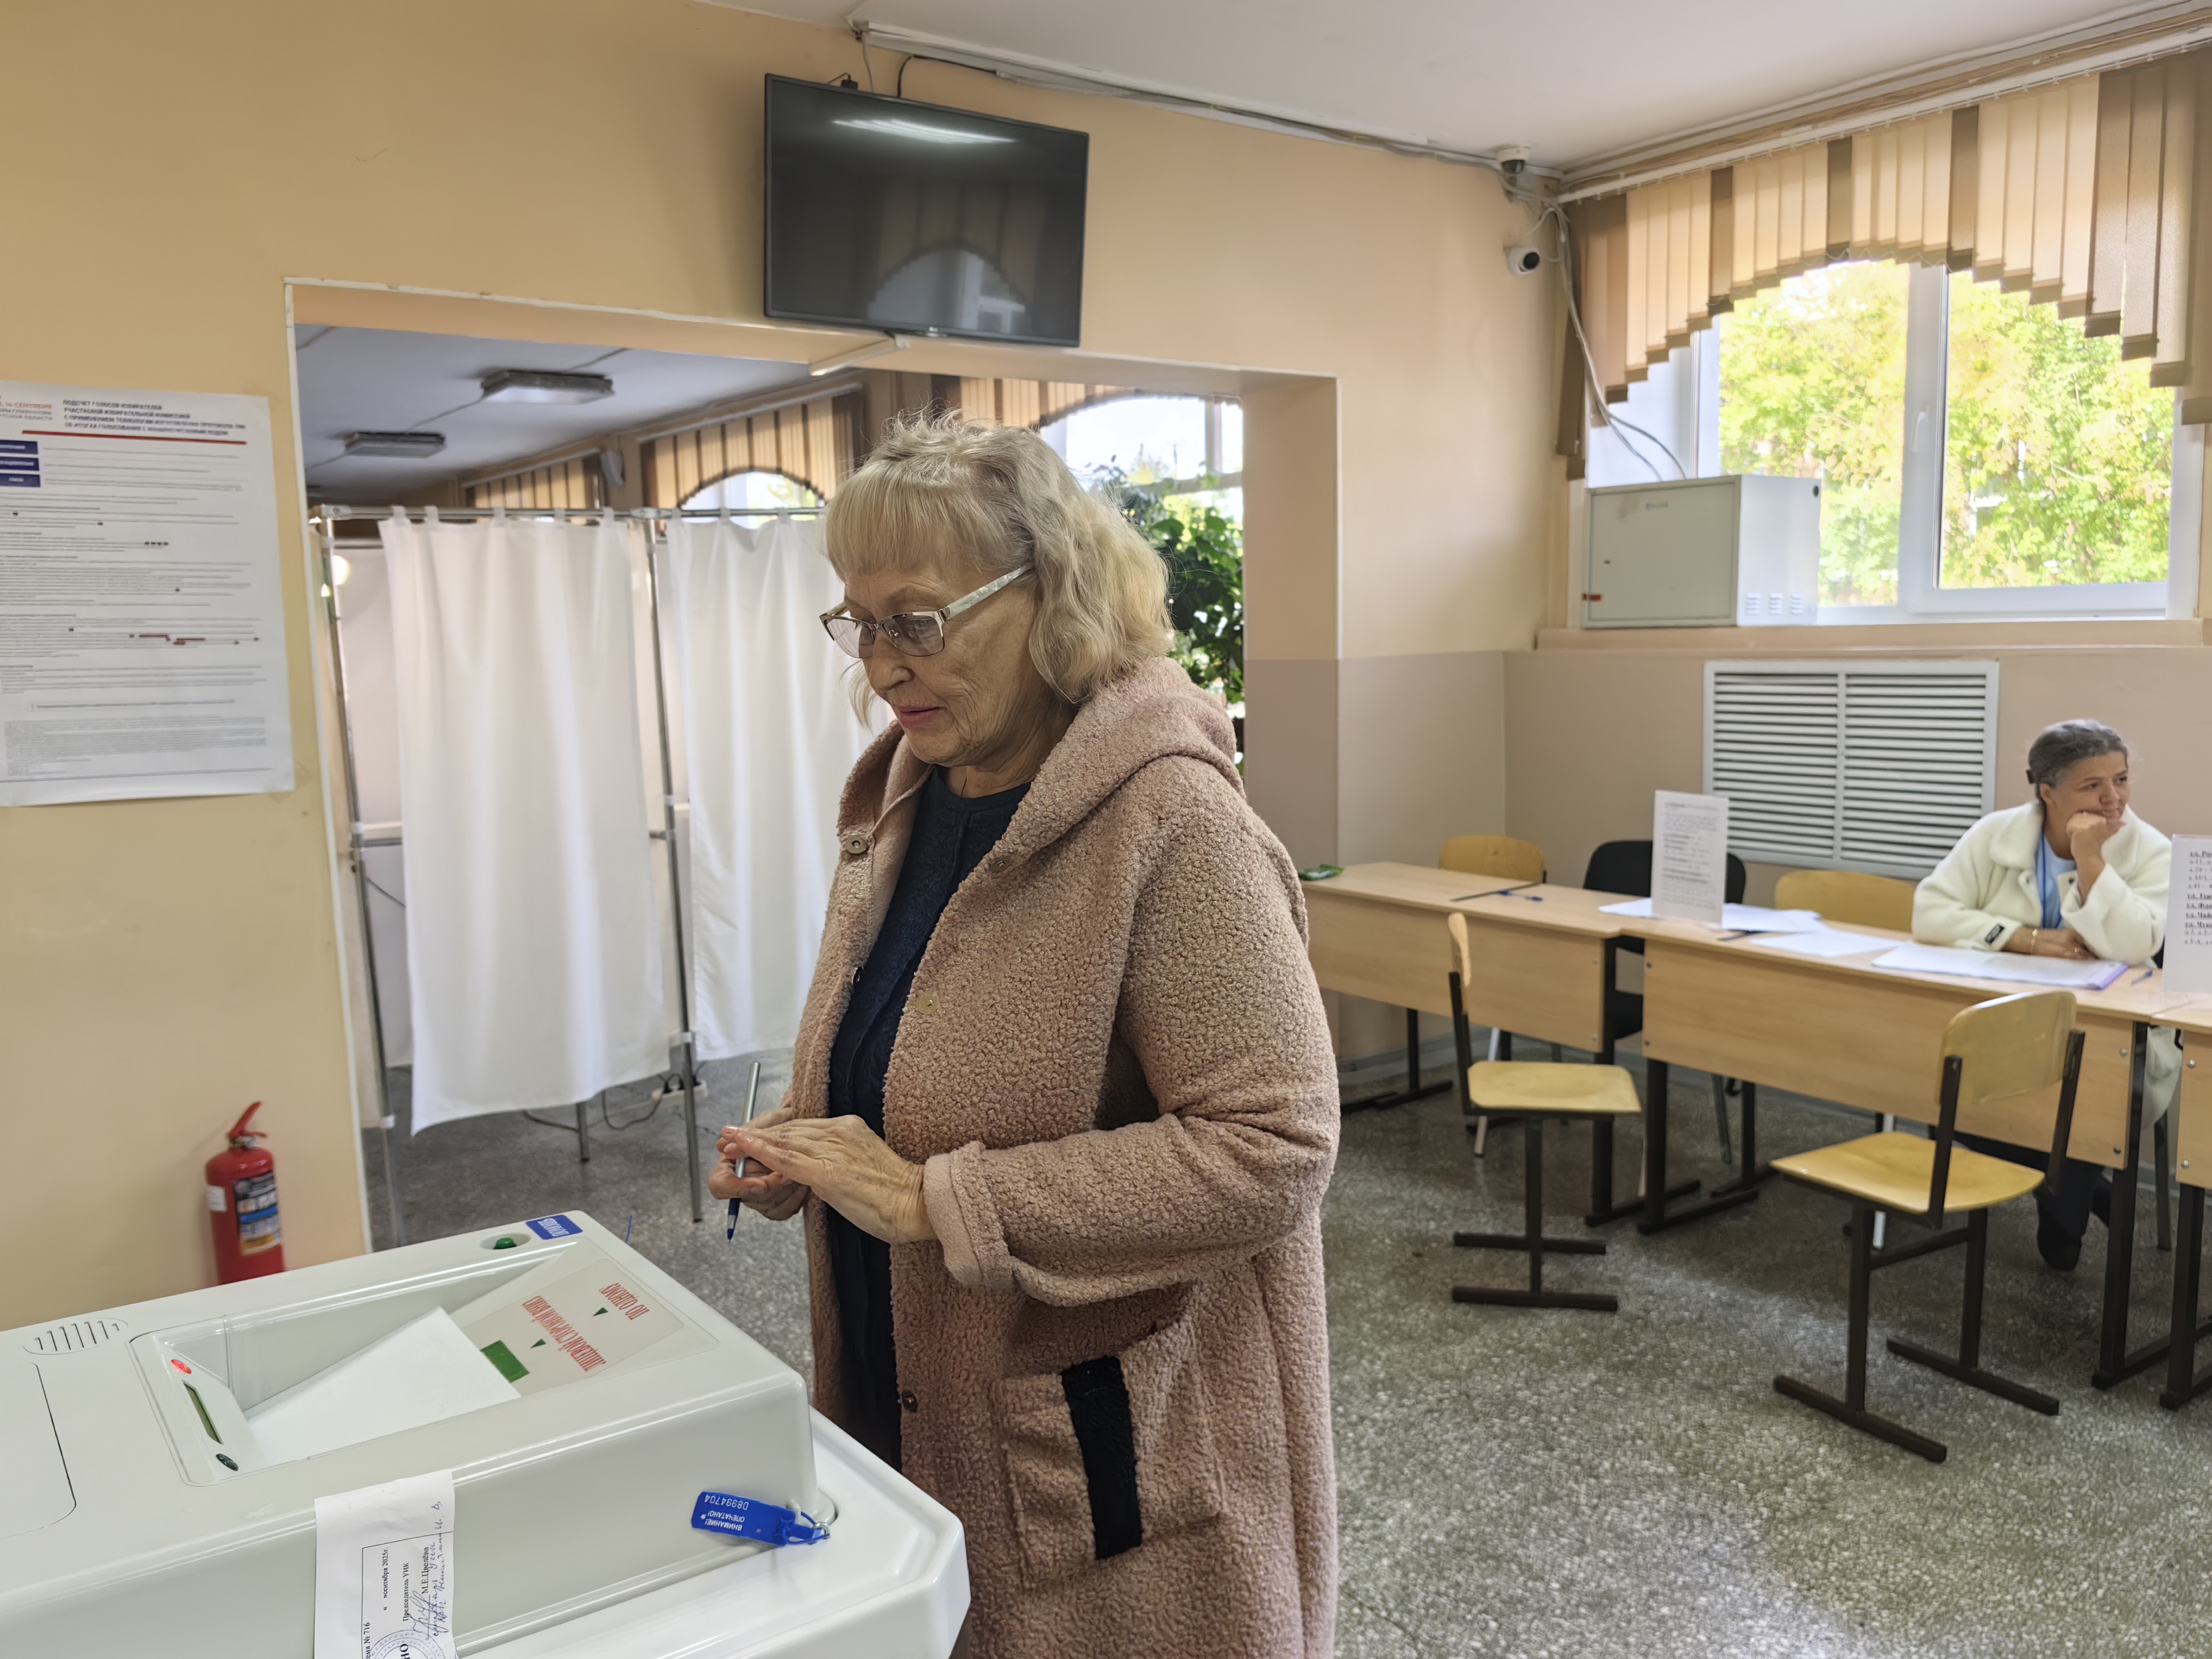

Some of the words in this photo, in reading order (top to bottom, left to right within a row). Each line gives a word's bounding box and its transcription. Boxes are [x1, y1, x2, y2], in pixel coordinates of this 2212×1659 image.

[522, 1296, 551, 1316] ВНИЗ
[625, 1305, 650, 1320] ПО
[707, 1510, 745, 1522] ОПЕЧАТАНО!
[705, 1519, 743, 1531] ВНИМАНИЕ!
